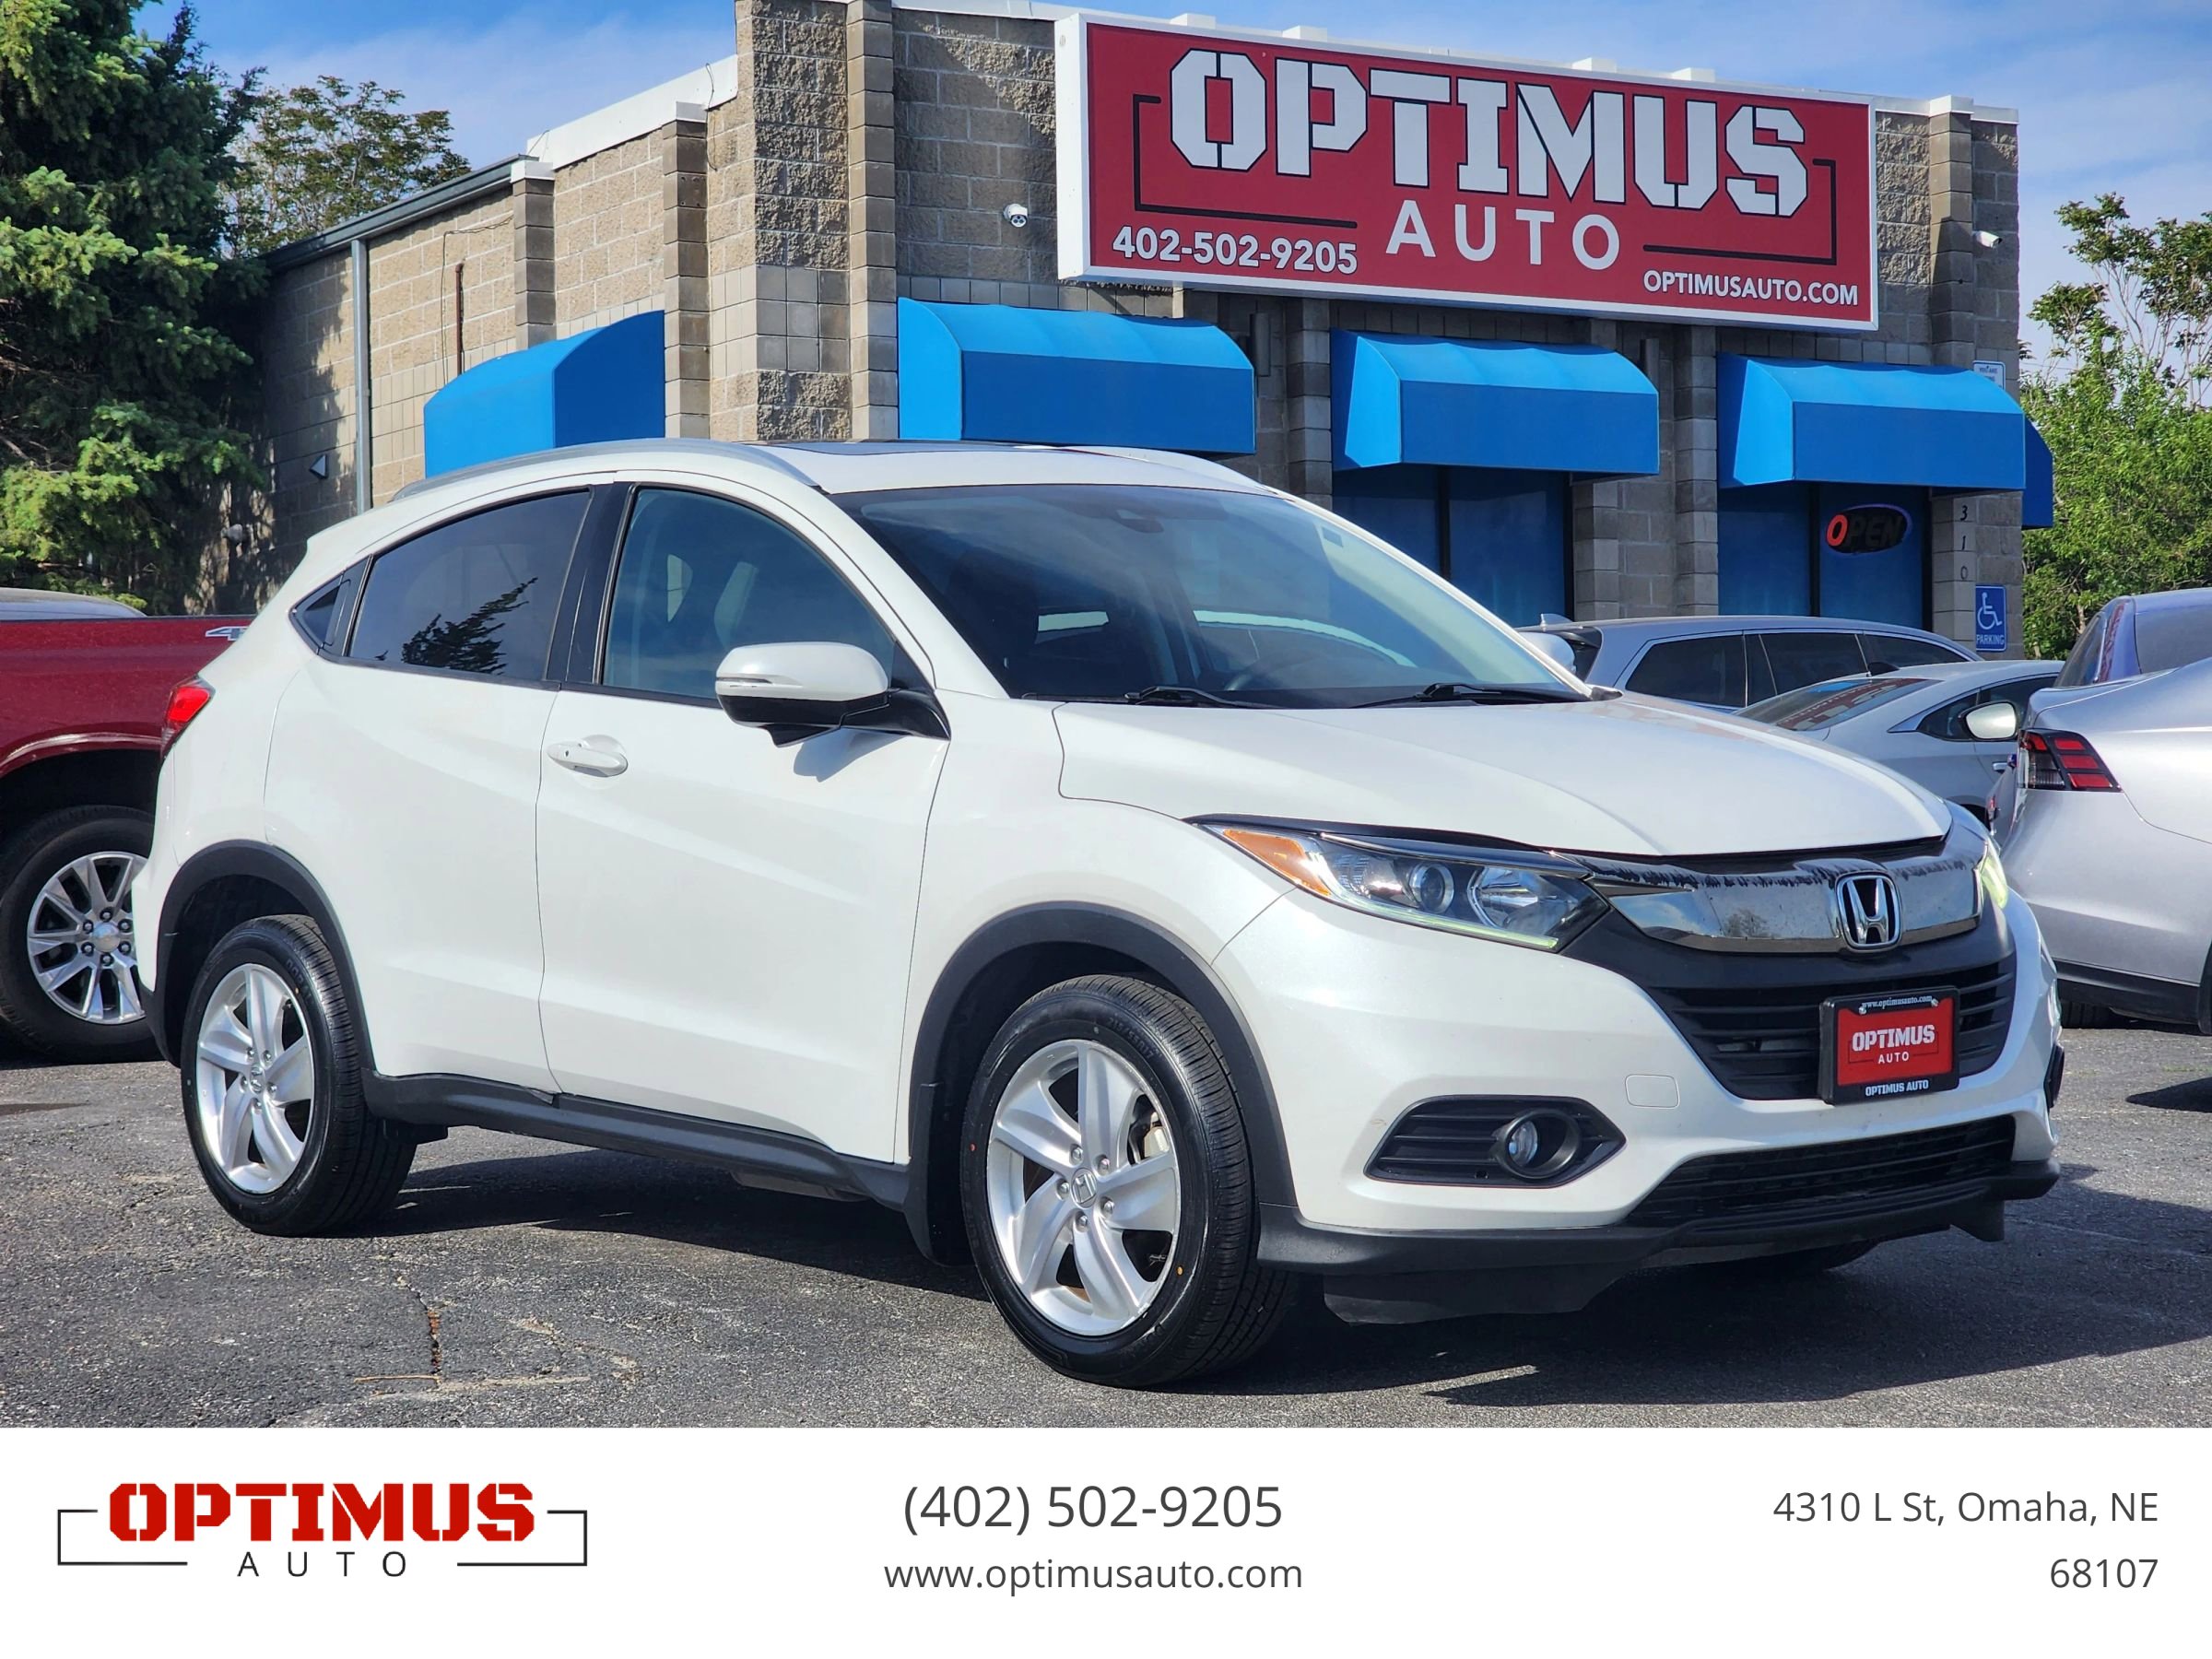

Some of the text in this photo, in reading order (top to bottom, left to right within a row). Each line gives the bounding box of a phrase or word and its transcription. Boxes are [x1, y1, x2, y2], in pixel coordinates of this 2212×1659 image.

[1171, 48, 1809, 218] OPTIMUS
[1386, 199, 1619, 270] AUTO
[1112, 226, 1359, 275] 402-502-9205
[1643, 270, 1860, 306] OPTIMUSAUTO.COM
[1827, 513, 1904, 547] OPEN
[1976, 634, 2005, 645] PARKING
[1862, 995, 1933, 1009] www.optimusauto.com
[1853, 1025, 1935, 1051] OPTIMUS
[1878, 1052, 1910, 1064] AUTO
[1865, 1080, 1929, 1097] OPTIMUS AUTO
